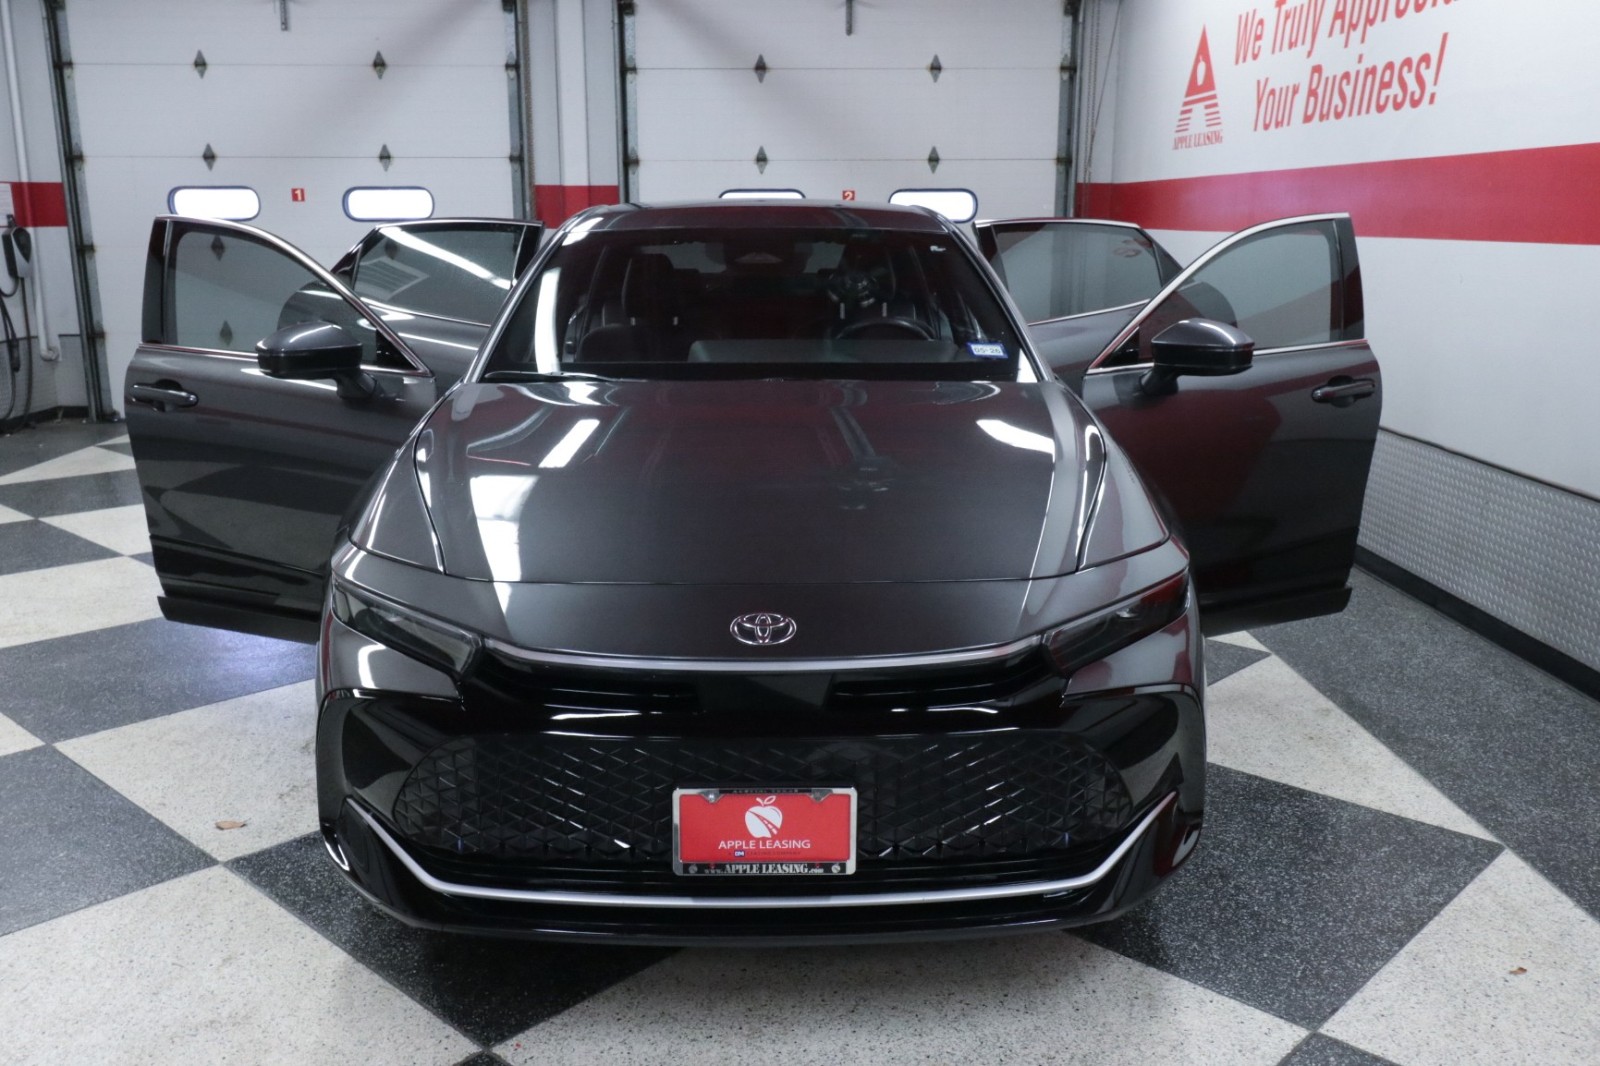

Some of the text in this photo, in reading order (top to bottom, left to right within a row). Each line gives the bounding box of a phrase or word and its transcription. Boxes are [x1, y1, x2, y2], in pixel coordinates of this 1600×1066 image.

[1235, 8, 1264, 65] We
[1271, 0, 1326, 58] Truly
[1253, 32, 1449, 131] Your Business!
[1172, 134, 1193, 150] APPLE
[718, 839, 811, 849] APPLE LEASING
